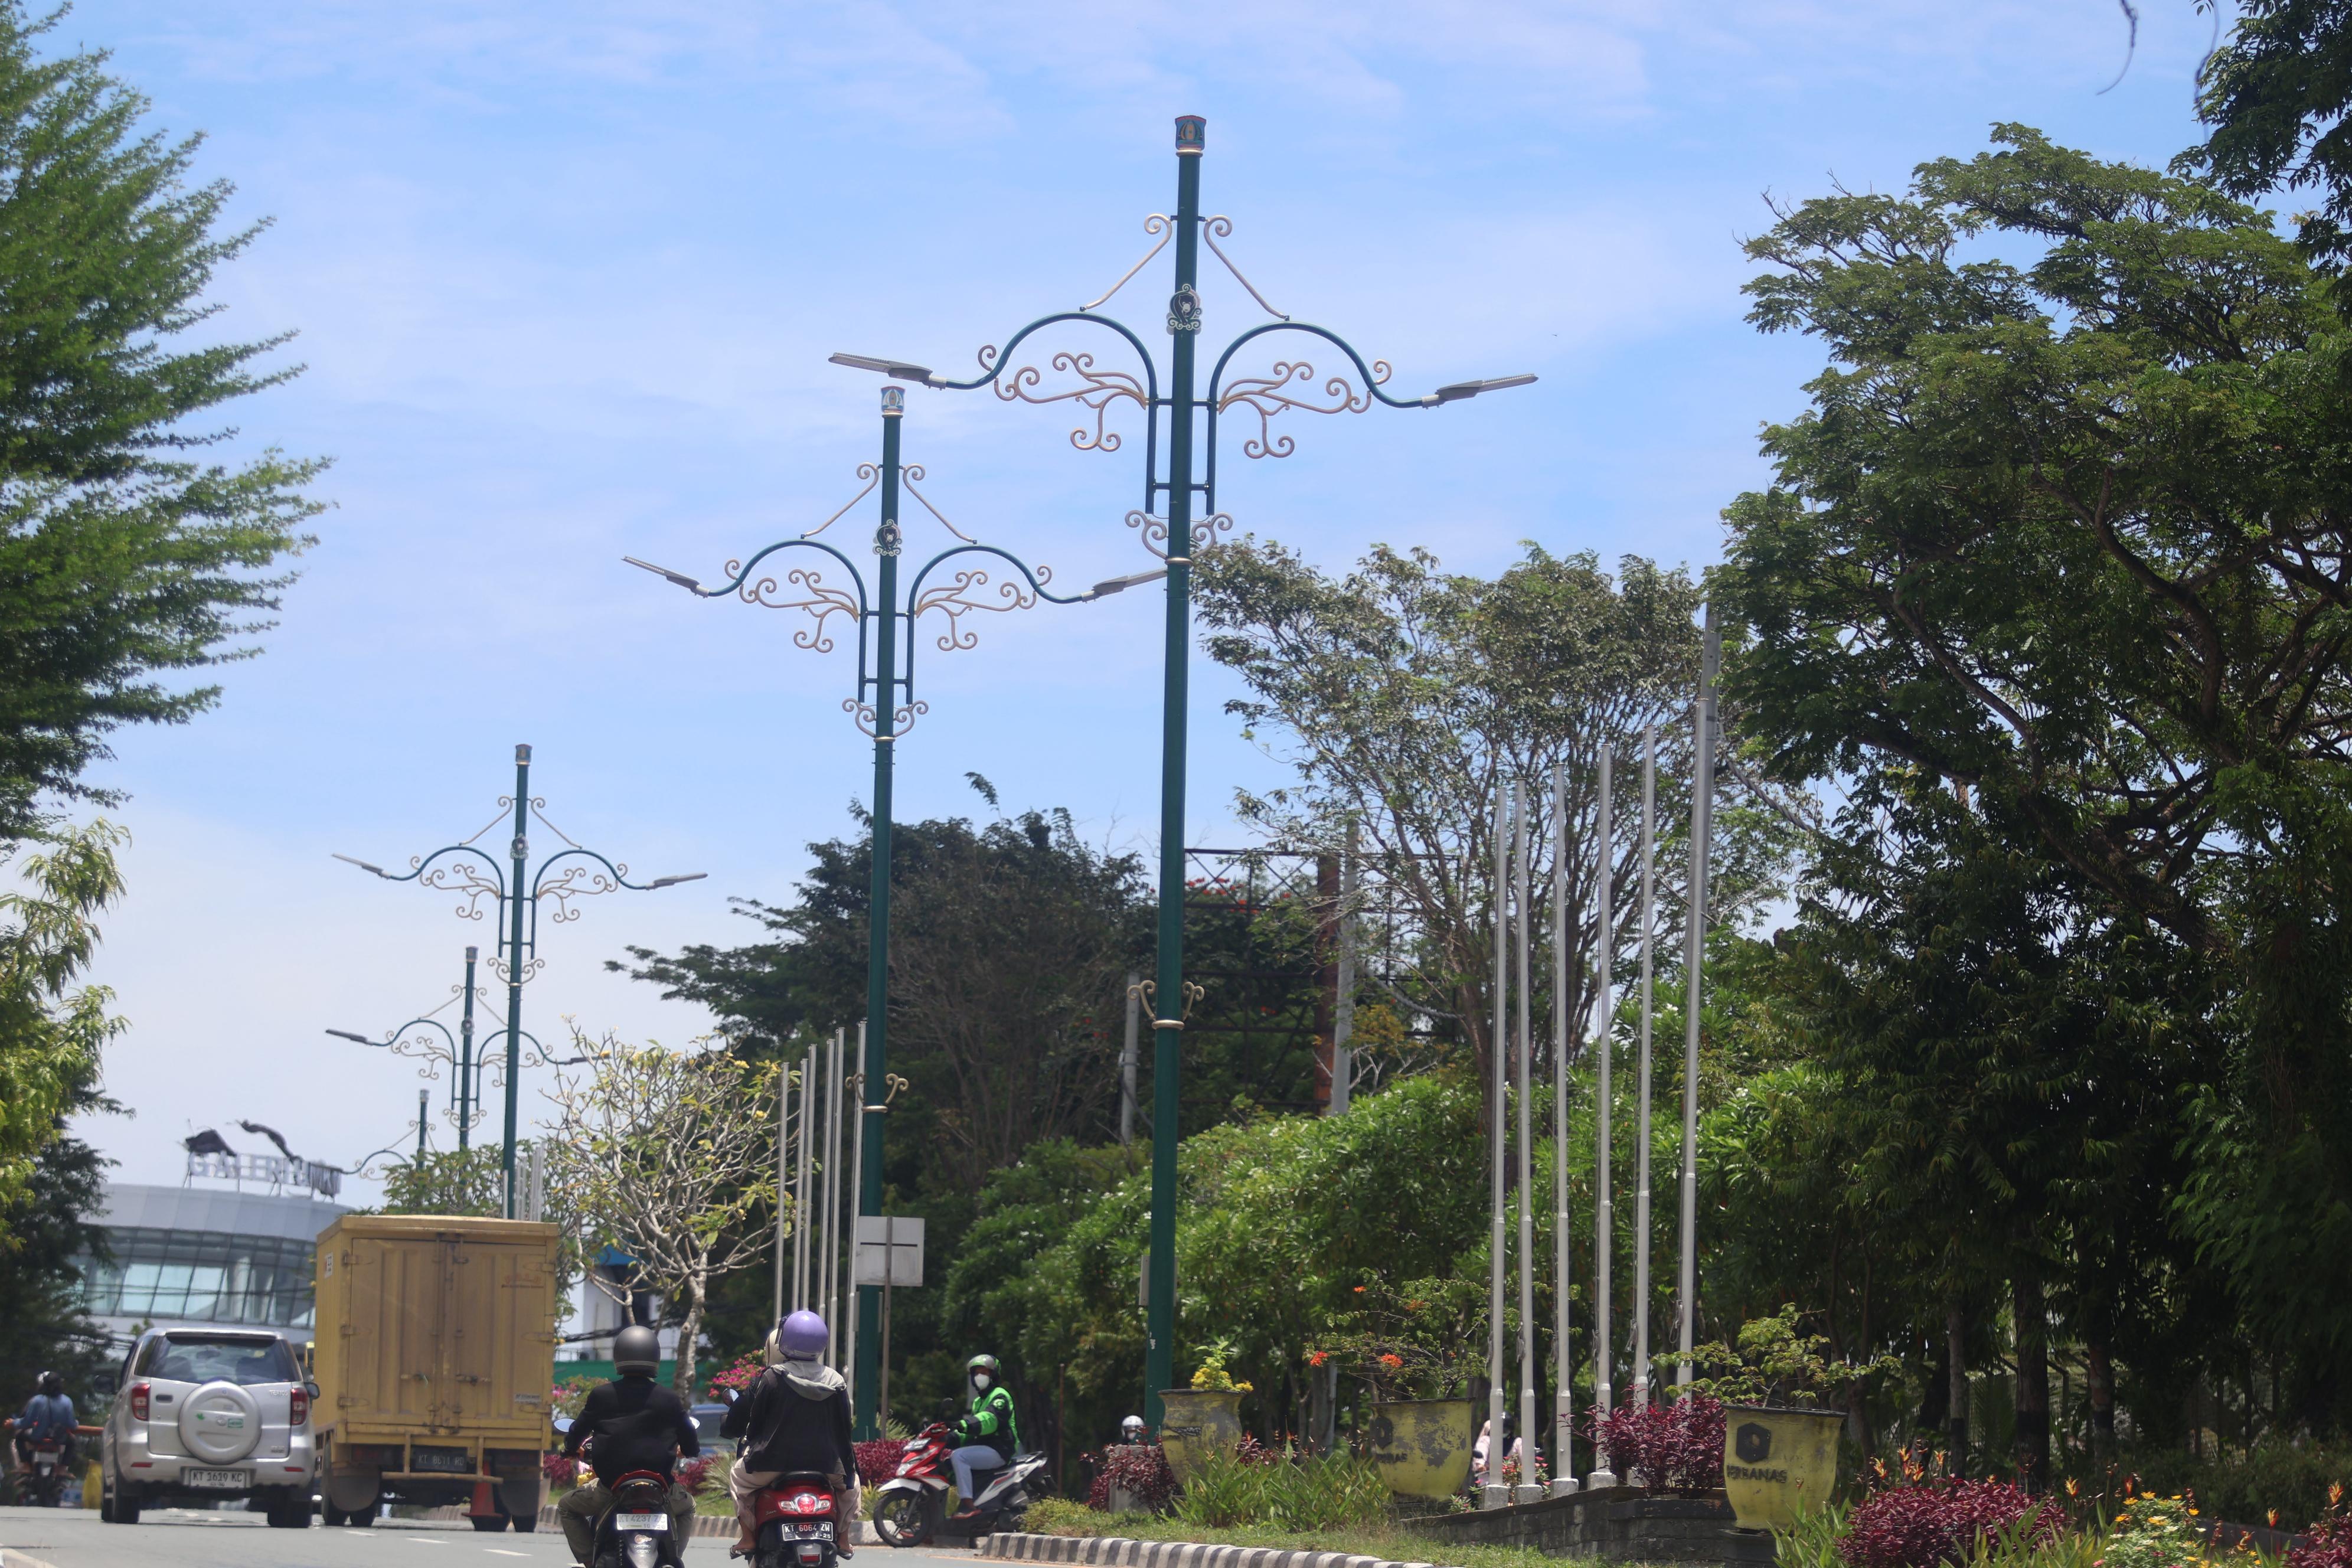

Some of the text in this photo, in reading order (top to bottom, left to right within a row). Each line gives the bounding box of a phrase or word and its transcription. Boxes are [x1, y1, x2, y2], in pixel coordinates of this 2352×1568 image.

[419, 1454, 427, 1464] KT
[193, 1471, 242, 1482] KT 1619 KC
